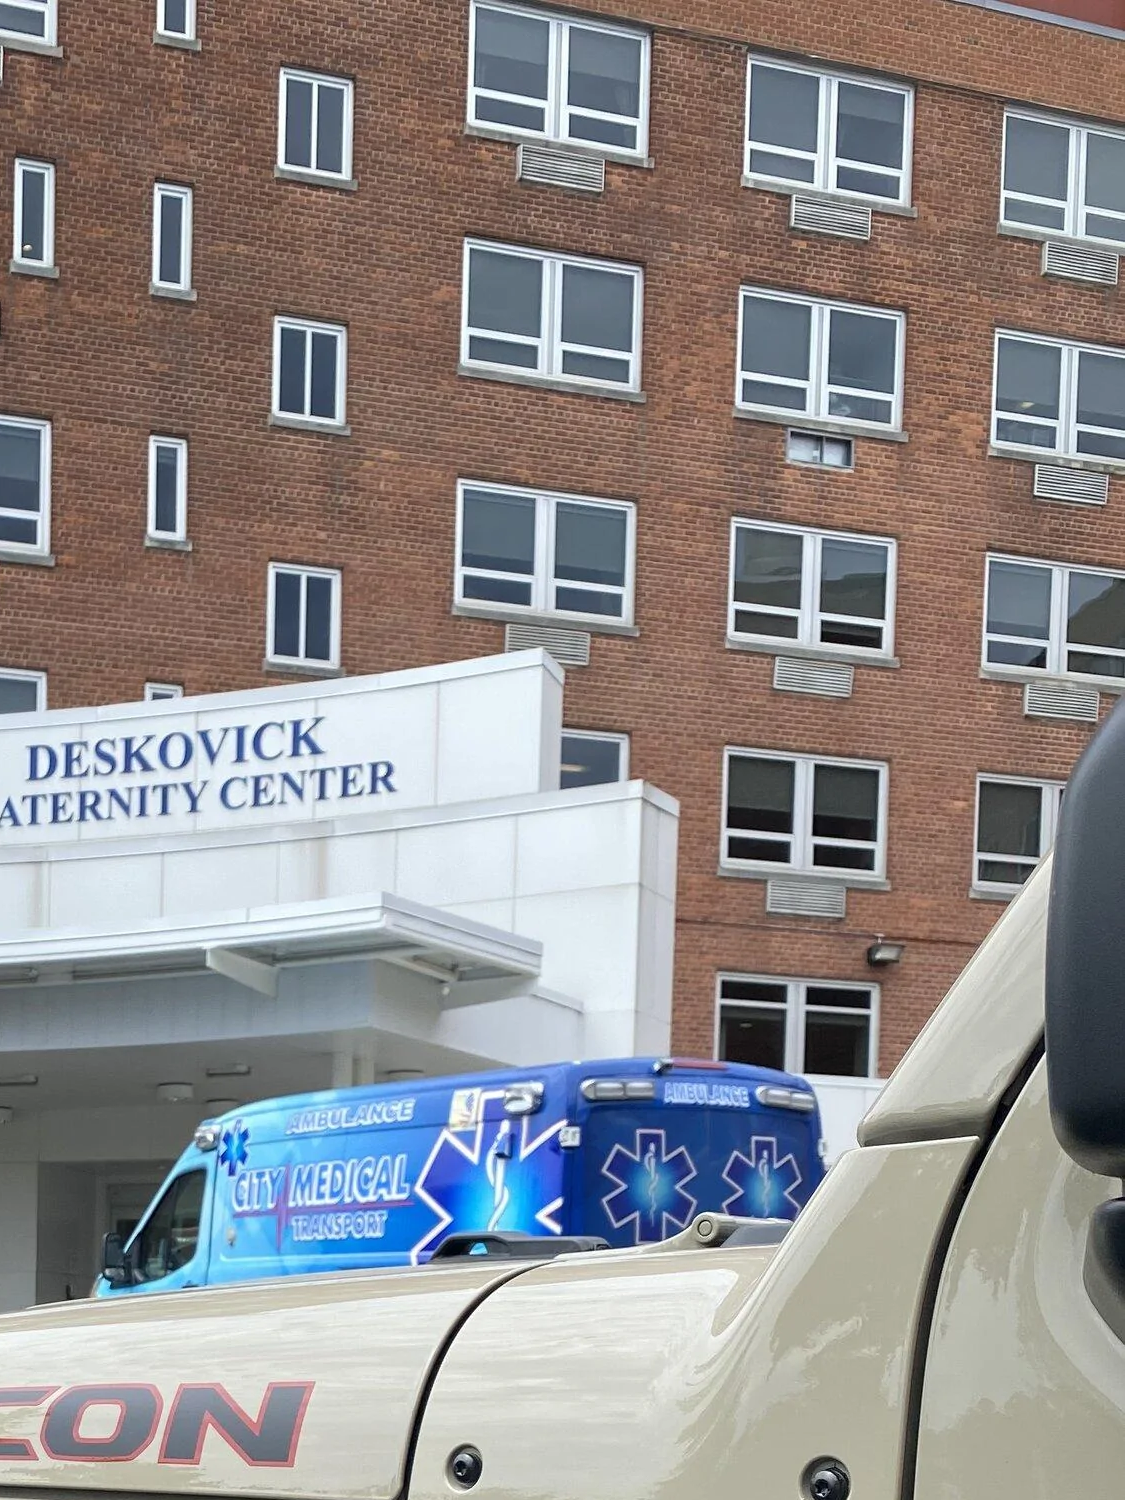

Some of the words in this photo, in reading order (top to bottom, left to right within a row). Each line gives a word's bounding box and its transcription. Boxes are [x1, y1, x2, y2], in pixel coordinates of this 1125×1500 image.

[25, 716, 326, 782] DESKOVICK
[220, 760, 398, 811] CENTER
[286, 1098, 416, 1135] AMBULANCE
[663, 1081, 750, 1108] AMBULANCE
[232, 1165, 287, 1214] CITY
[288, 1153, 411, 1208] MEDICAL
[291, 1210, 389, 1242] TRANSPORT
